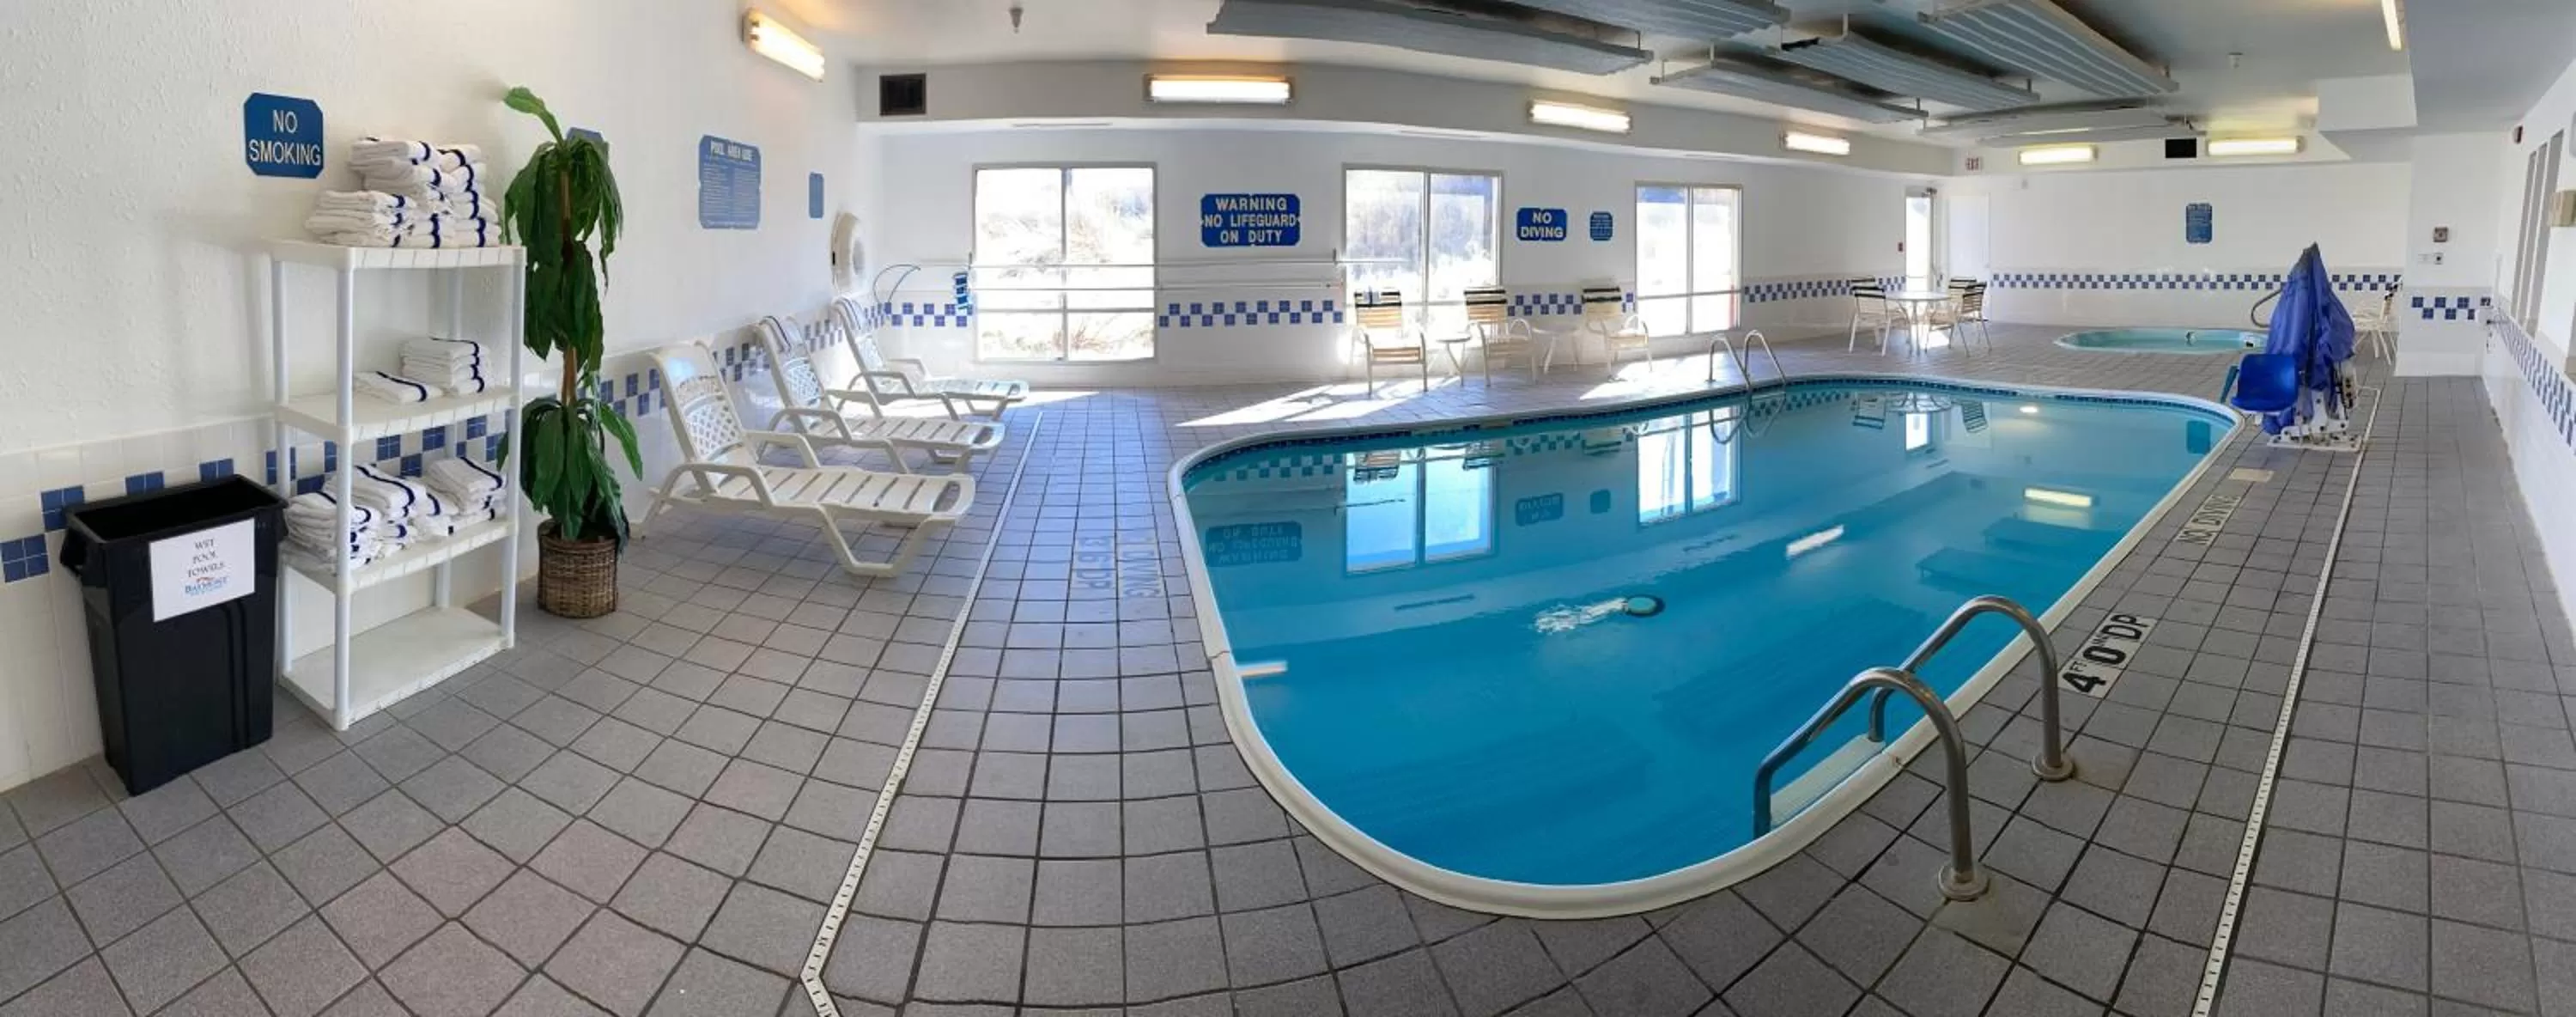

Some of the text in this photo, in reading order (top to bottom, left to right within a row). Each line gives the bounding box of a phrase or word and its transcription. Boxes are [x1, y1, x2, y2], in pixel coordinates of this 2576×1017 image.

[272, 109, 299, 134] NO
[248, 138, 322, 166] SMOKING
[1215, 197, 1288, 211] WARNING
[1204, 213, 1297, 228] NO LIFEGUARD
[1532, 211, 1553, 224] NO
[1219, 229, 1283, 244] ON DUTY
[1520, 225, 1564, 238] DIVING
[194, 539, 215, 551] WET
[2101, 614, 2150, 640] DP
